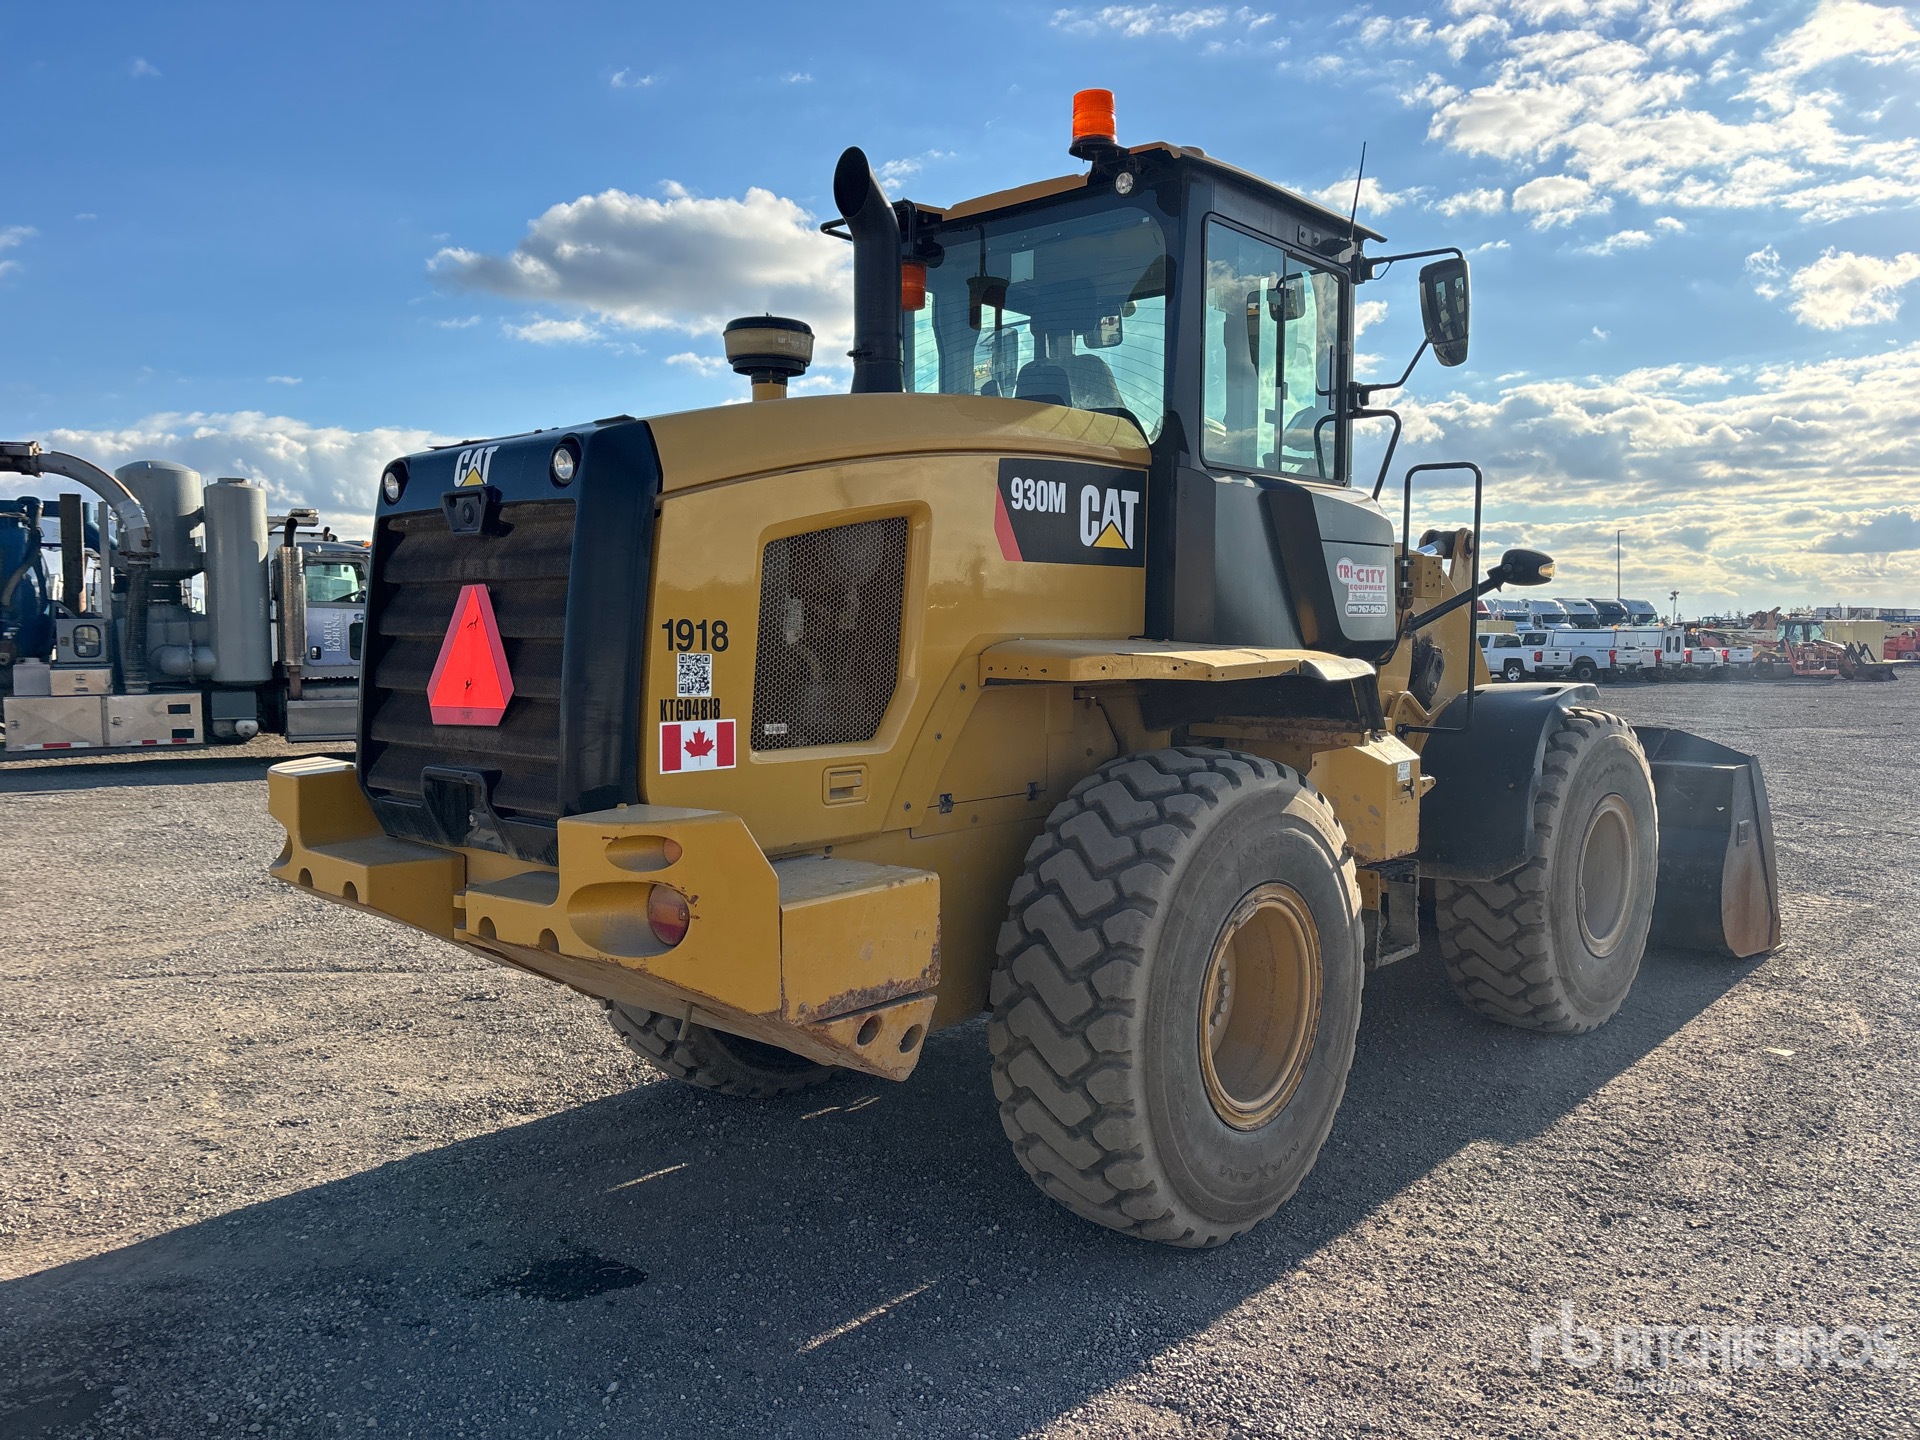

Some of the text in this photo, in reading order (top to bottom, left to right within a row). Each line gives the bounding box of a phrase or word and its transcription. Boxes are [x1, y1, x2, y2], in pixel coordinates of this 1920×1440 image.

[453, 445, 500, 488] CAT
[1010, 476, 1140, 550] 930M CAT
[1338, 564, 1385, 583] TRI-CITY
[324, 621, 332, 651] EARTH
[332, 611, 340, 651] BORING
[661, 618, 729, 652] 1918
[659, 698, 721, 721] KTG04818
